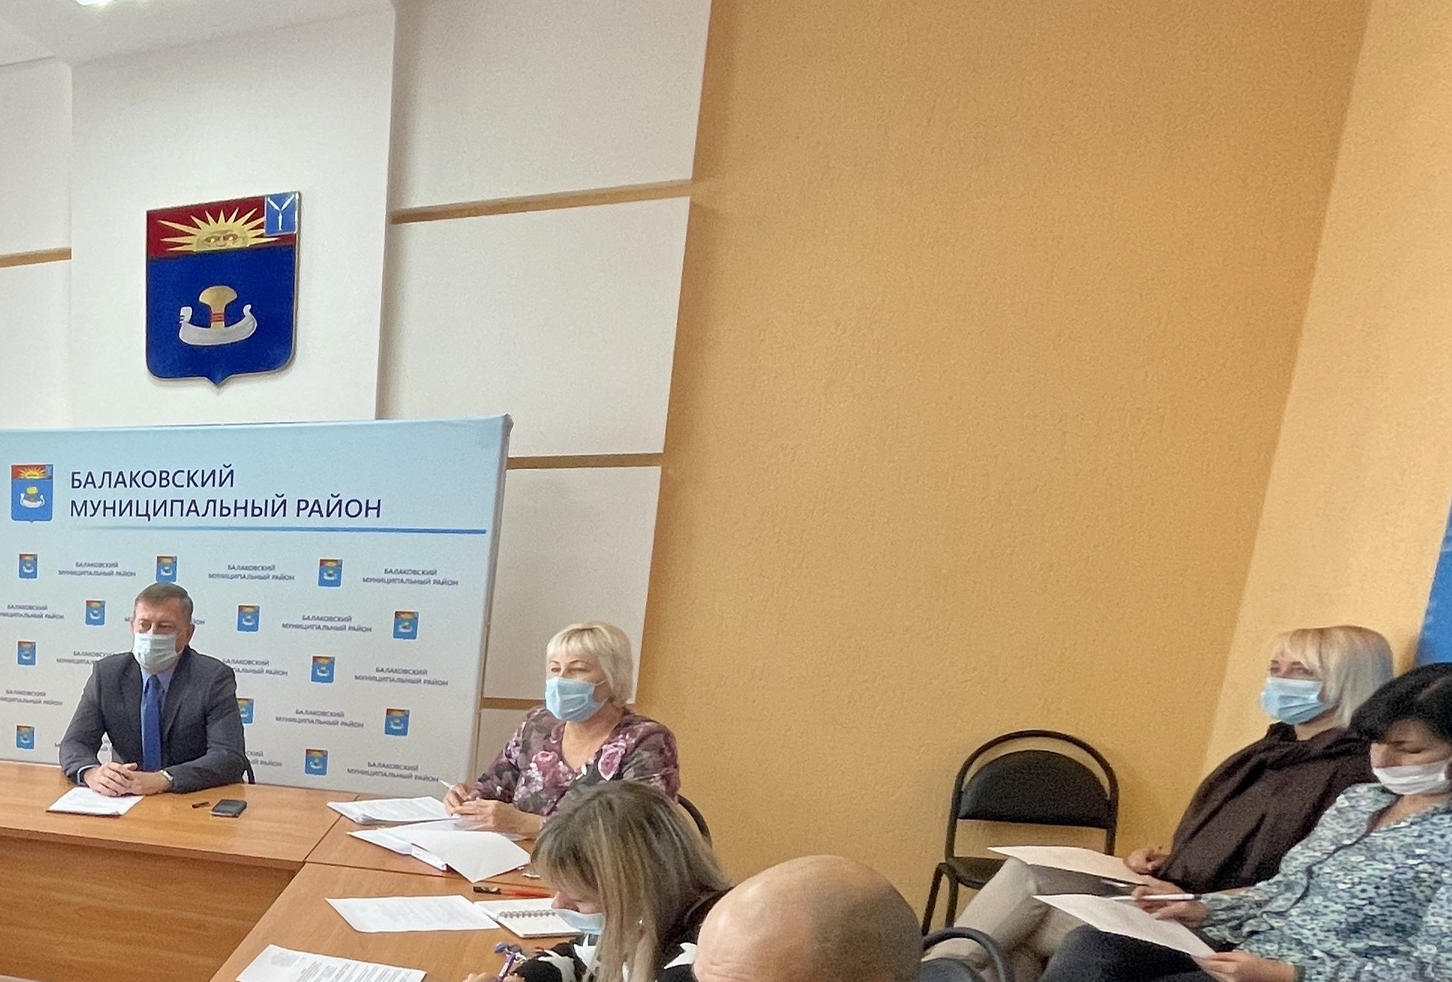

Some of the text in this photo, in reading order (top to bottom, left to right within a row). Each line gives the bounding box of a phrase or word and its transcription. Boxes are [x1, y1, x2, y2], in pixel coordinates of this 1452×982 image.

[70, 464, 235, 490] БАЛАКОВСКИЙ
[69, 493, 382, 522] МУНИЦИПАЛЬНЫЙ РАЙОН
